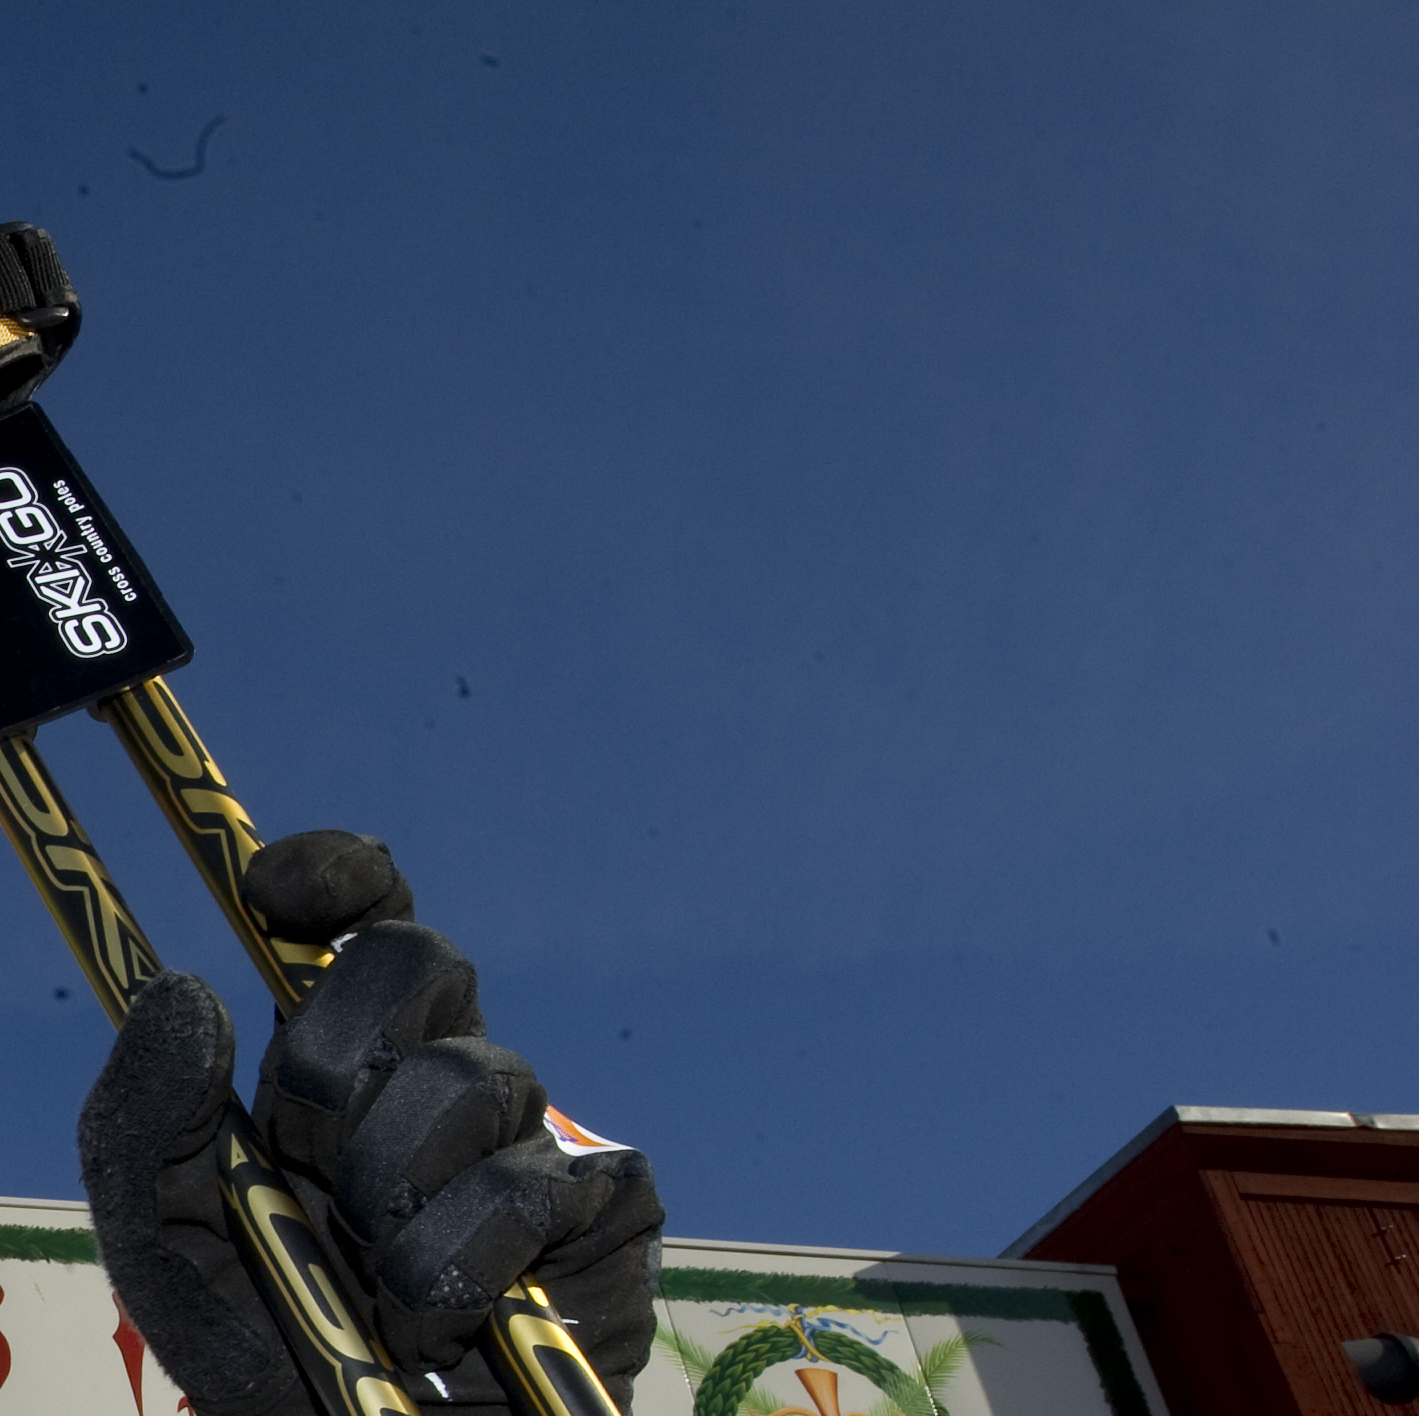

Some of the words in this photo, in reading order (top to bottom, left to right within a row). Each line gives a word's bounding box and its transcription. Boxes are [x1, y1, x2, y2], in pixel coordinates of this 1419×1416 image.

[53, 479, 85, 514] poles
[75, 515, 113, 563] country
[107, 566, 138, 602] cross
